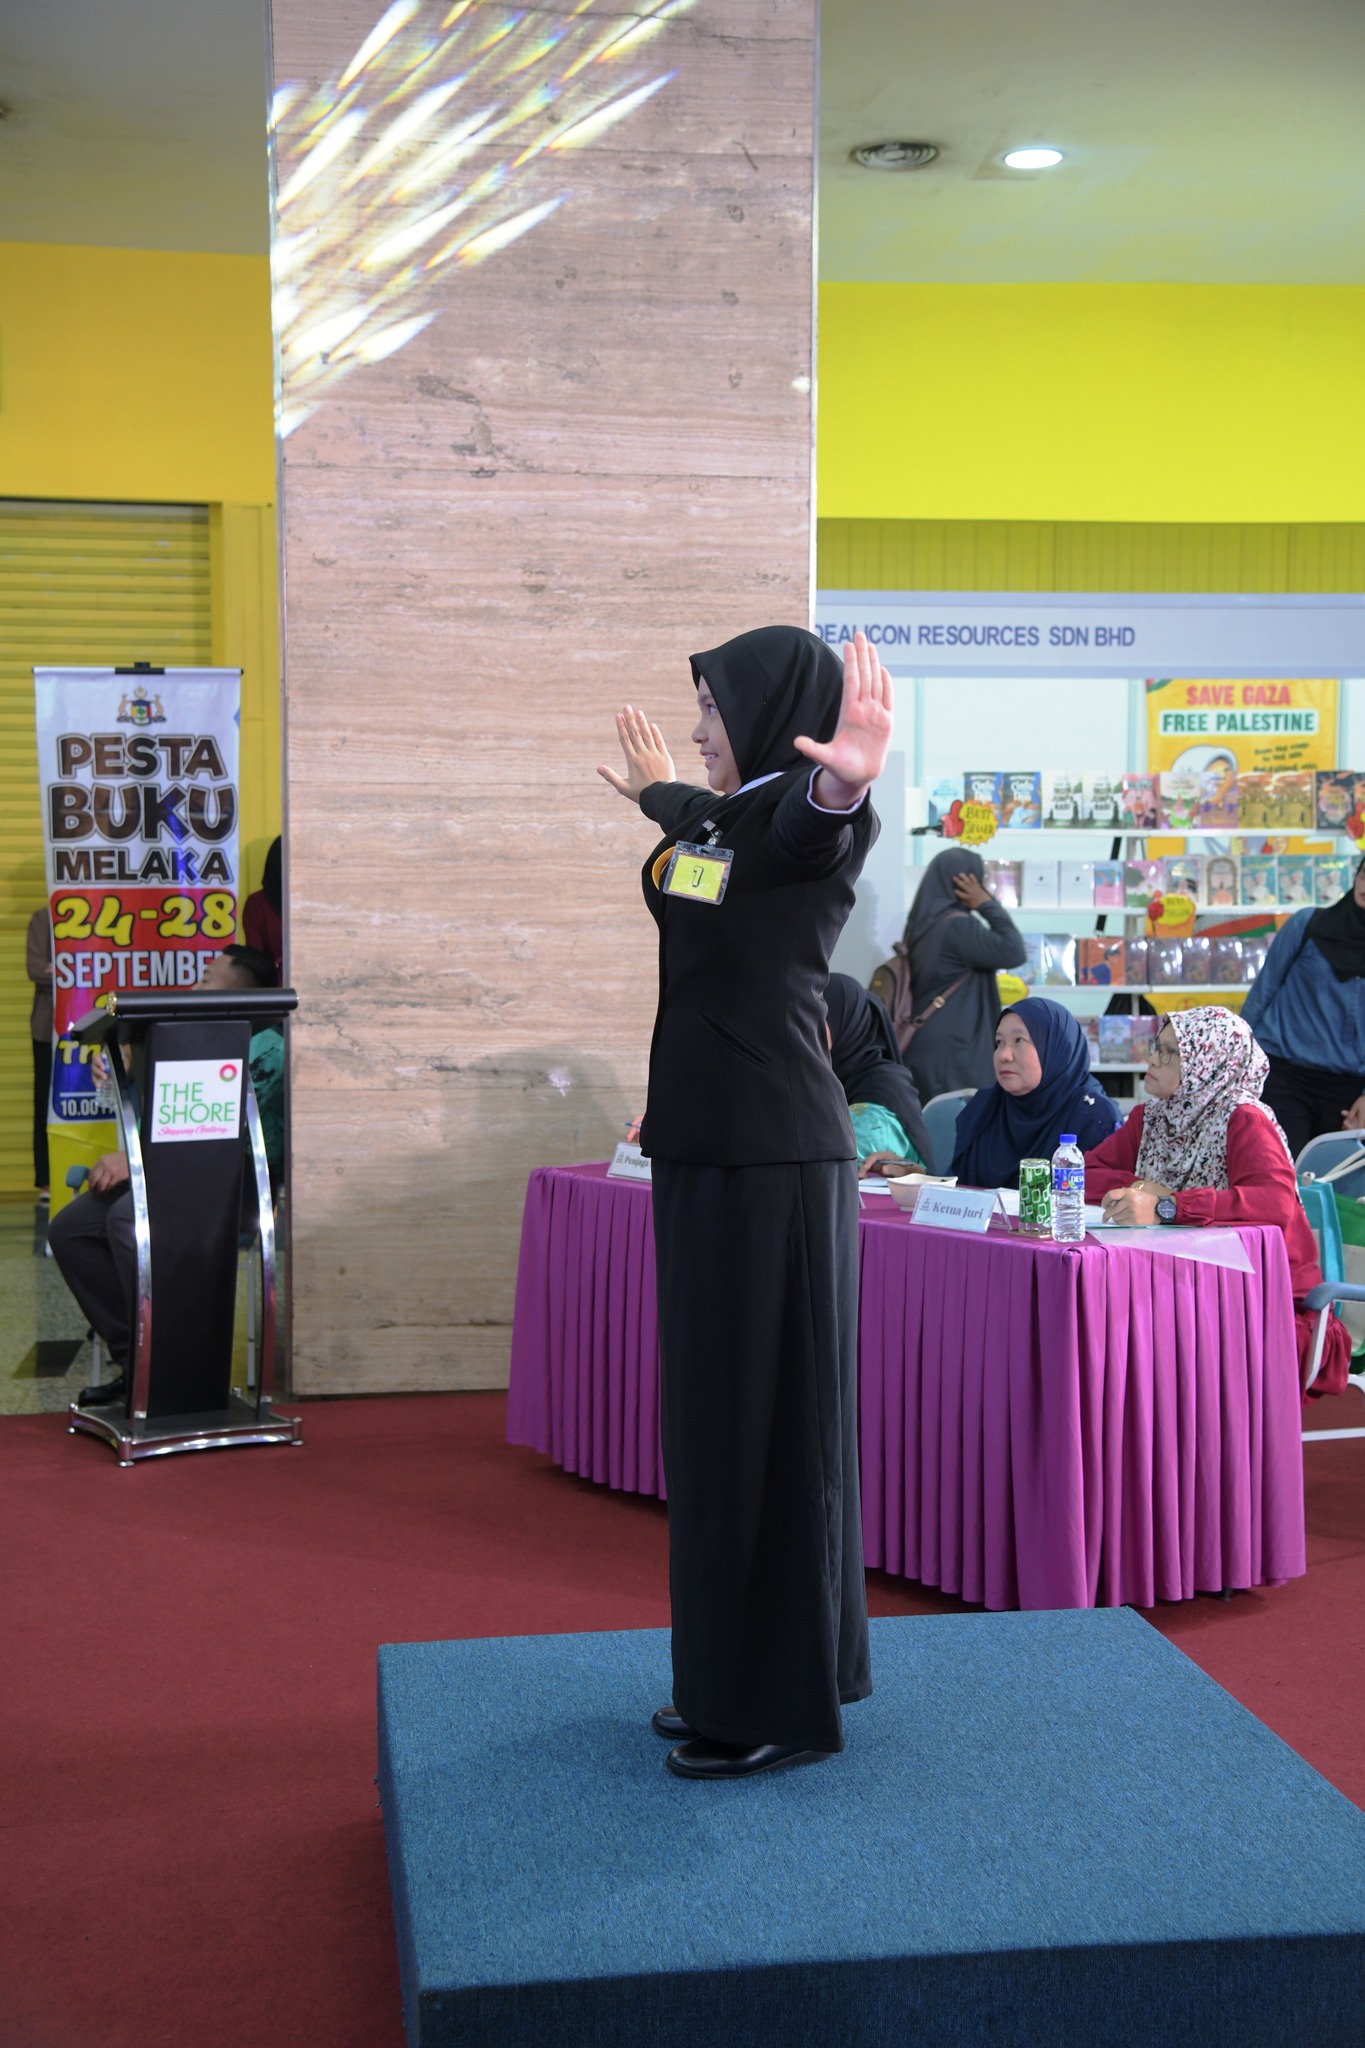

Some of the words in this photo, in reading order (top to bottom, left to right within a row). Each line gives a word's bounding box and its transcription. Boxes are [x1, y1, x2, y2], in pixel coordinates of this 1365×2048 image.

[917, 624, 1040, 646] RESOURCES
[1049, 626, 1089, 646] SDN
[1094, 627, 1136, 647] BHD
[1186, 685, 1235, 706] SAVE
[1243, 685, 1292, 706] GAZA
[1162, 713, 1208, 732] FREE
[1216, 713, 1315, 732] PALESTINE
[57, 733, 228, 781] PESTA
[48, 783, 238, 844] BUKU
[53, 847, 234, 886] MELAKA
[692, 865, 704, 888] 1
[53, 891, 237, 946] 24-28
[55, 950, 223, 989] SEPTEMBE
[159, 1082, 203, 1103] THE
[159, 1102, 236, 1125] SHORE
[932, 1201, 961, 1216] Ketua
[962, 1204, 984, 1220] Juri
